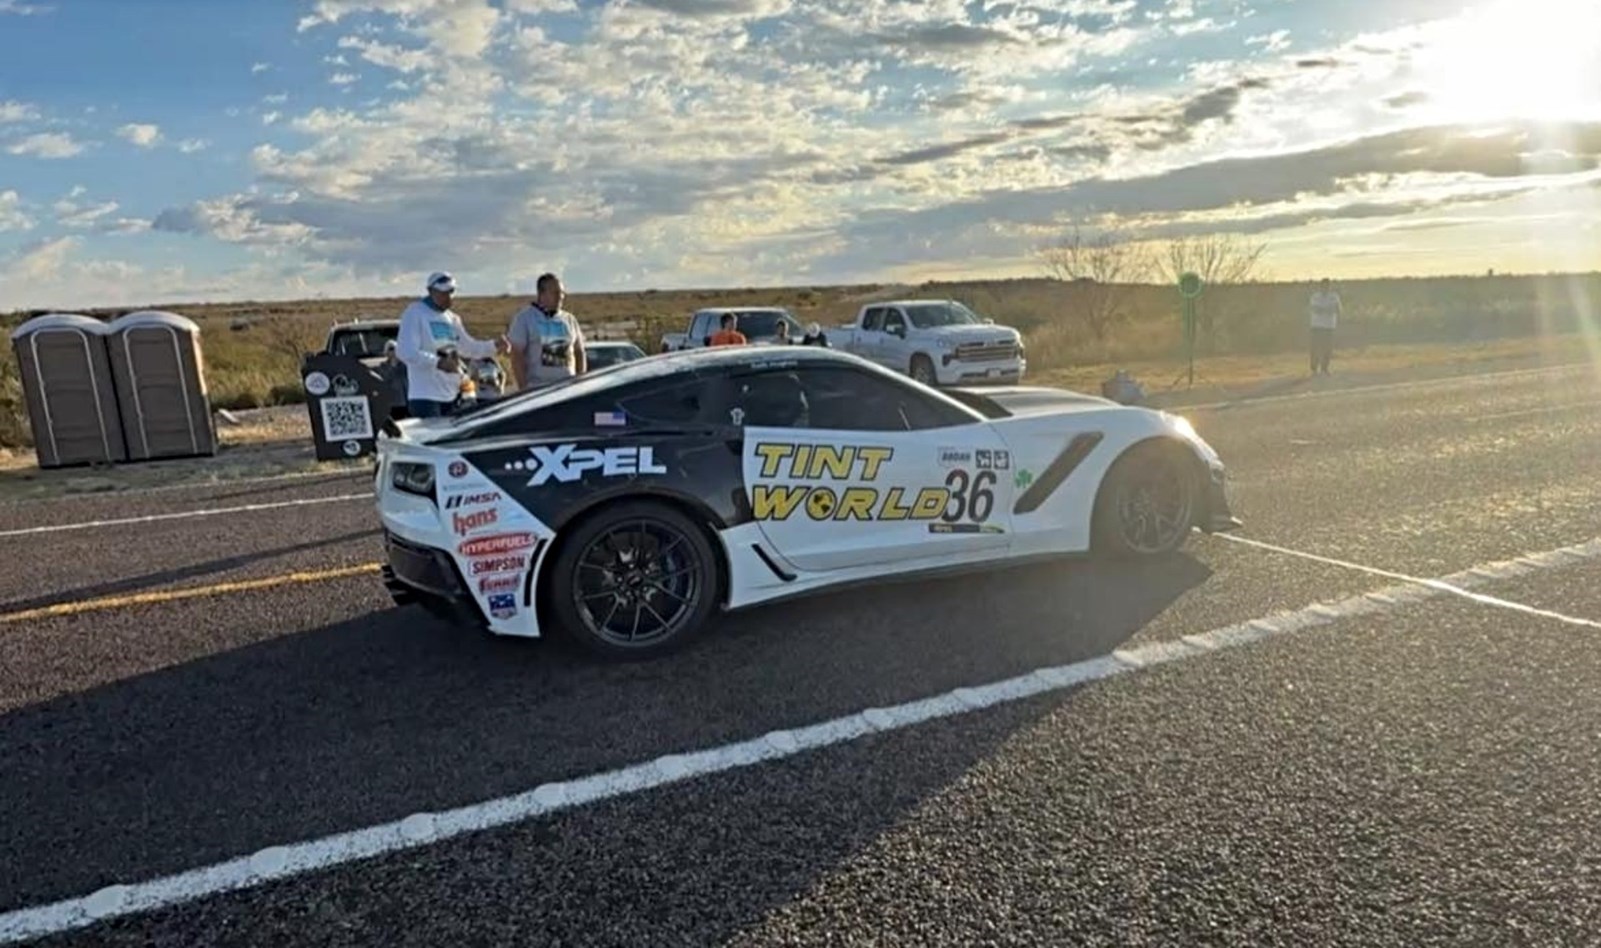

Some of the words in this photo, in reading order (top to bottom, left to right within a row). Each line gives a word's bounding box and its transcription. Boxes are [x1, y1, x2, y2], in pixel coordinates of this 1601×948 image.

[526, 443, 667, 487] XPEL
[754, 442, 894, 481] TINT
[463, 492, 502, 506] IMSA
[751, 484, 950, 521] WORLD
[941, 468, 997, 523] 36
[452, 508, 498, 536] hans
[473, 557, 524, 574] SIMPSON
